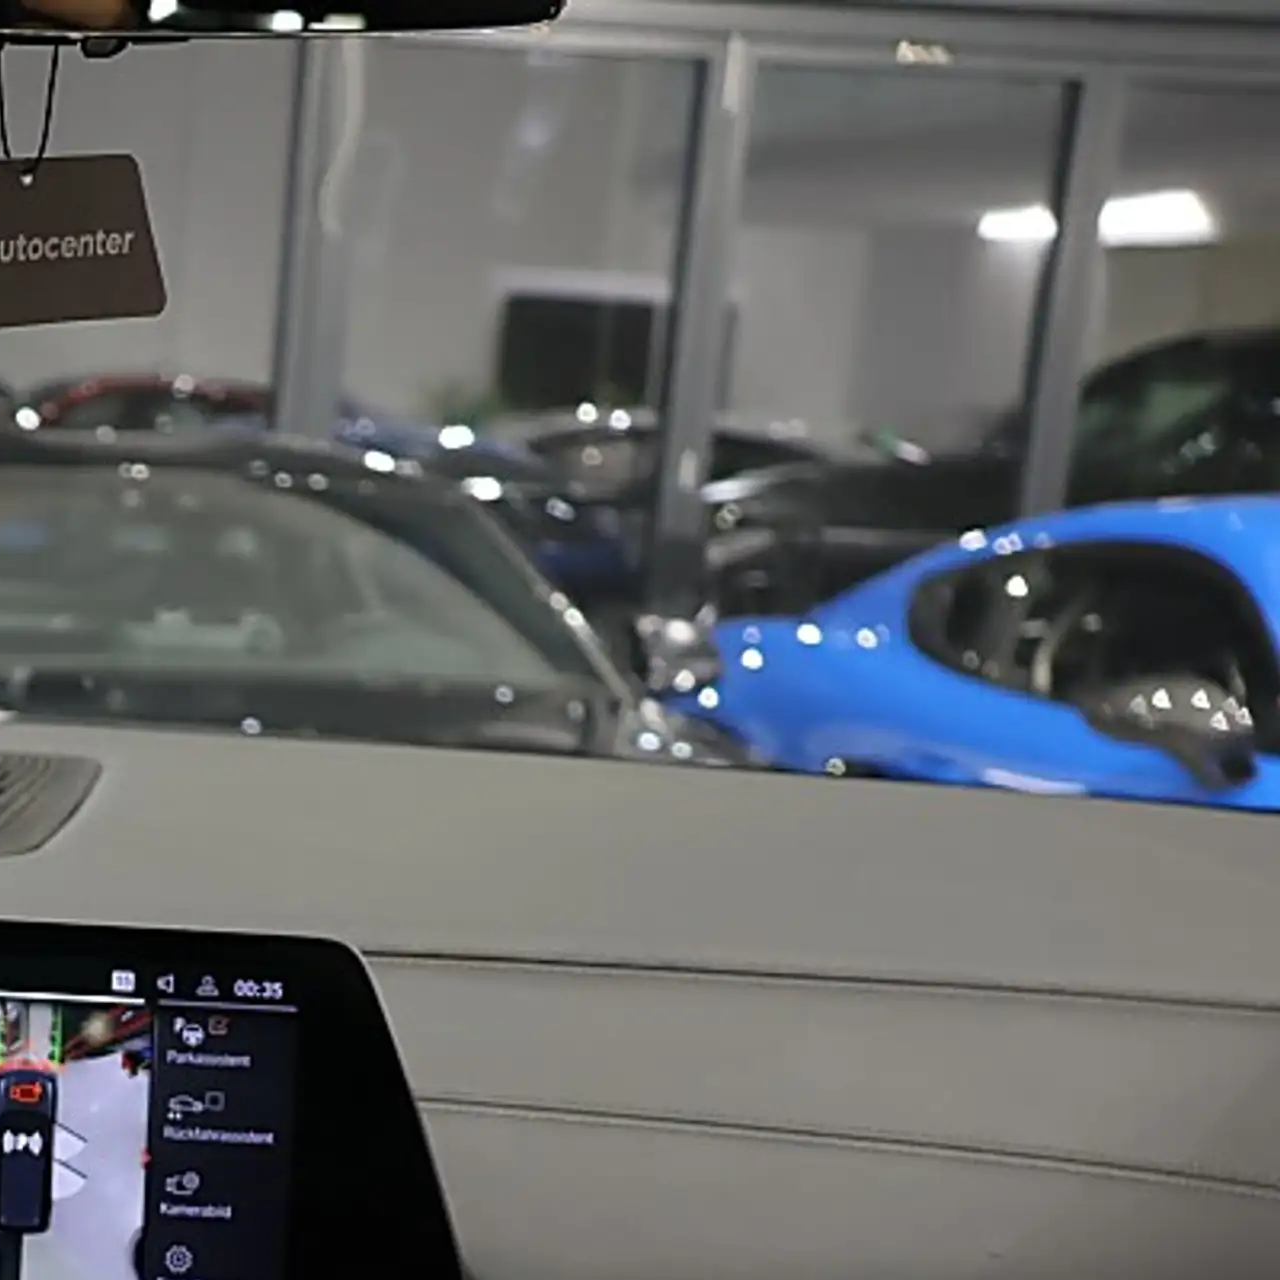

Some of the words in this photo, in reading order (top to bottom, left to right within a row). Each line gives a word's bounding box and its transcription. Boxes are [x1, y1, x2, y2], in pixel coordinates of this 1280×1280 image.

[233, 979, 284, 1000] 00:35
[166, 1050, 252, 1068] Parkassistent
[159, 1202, 233, 1219] Kamerabild
